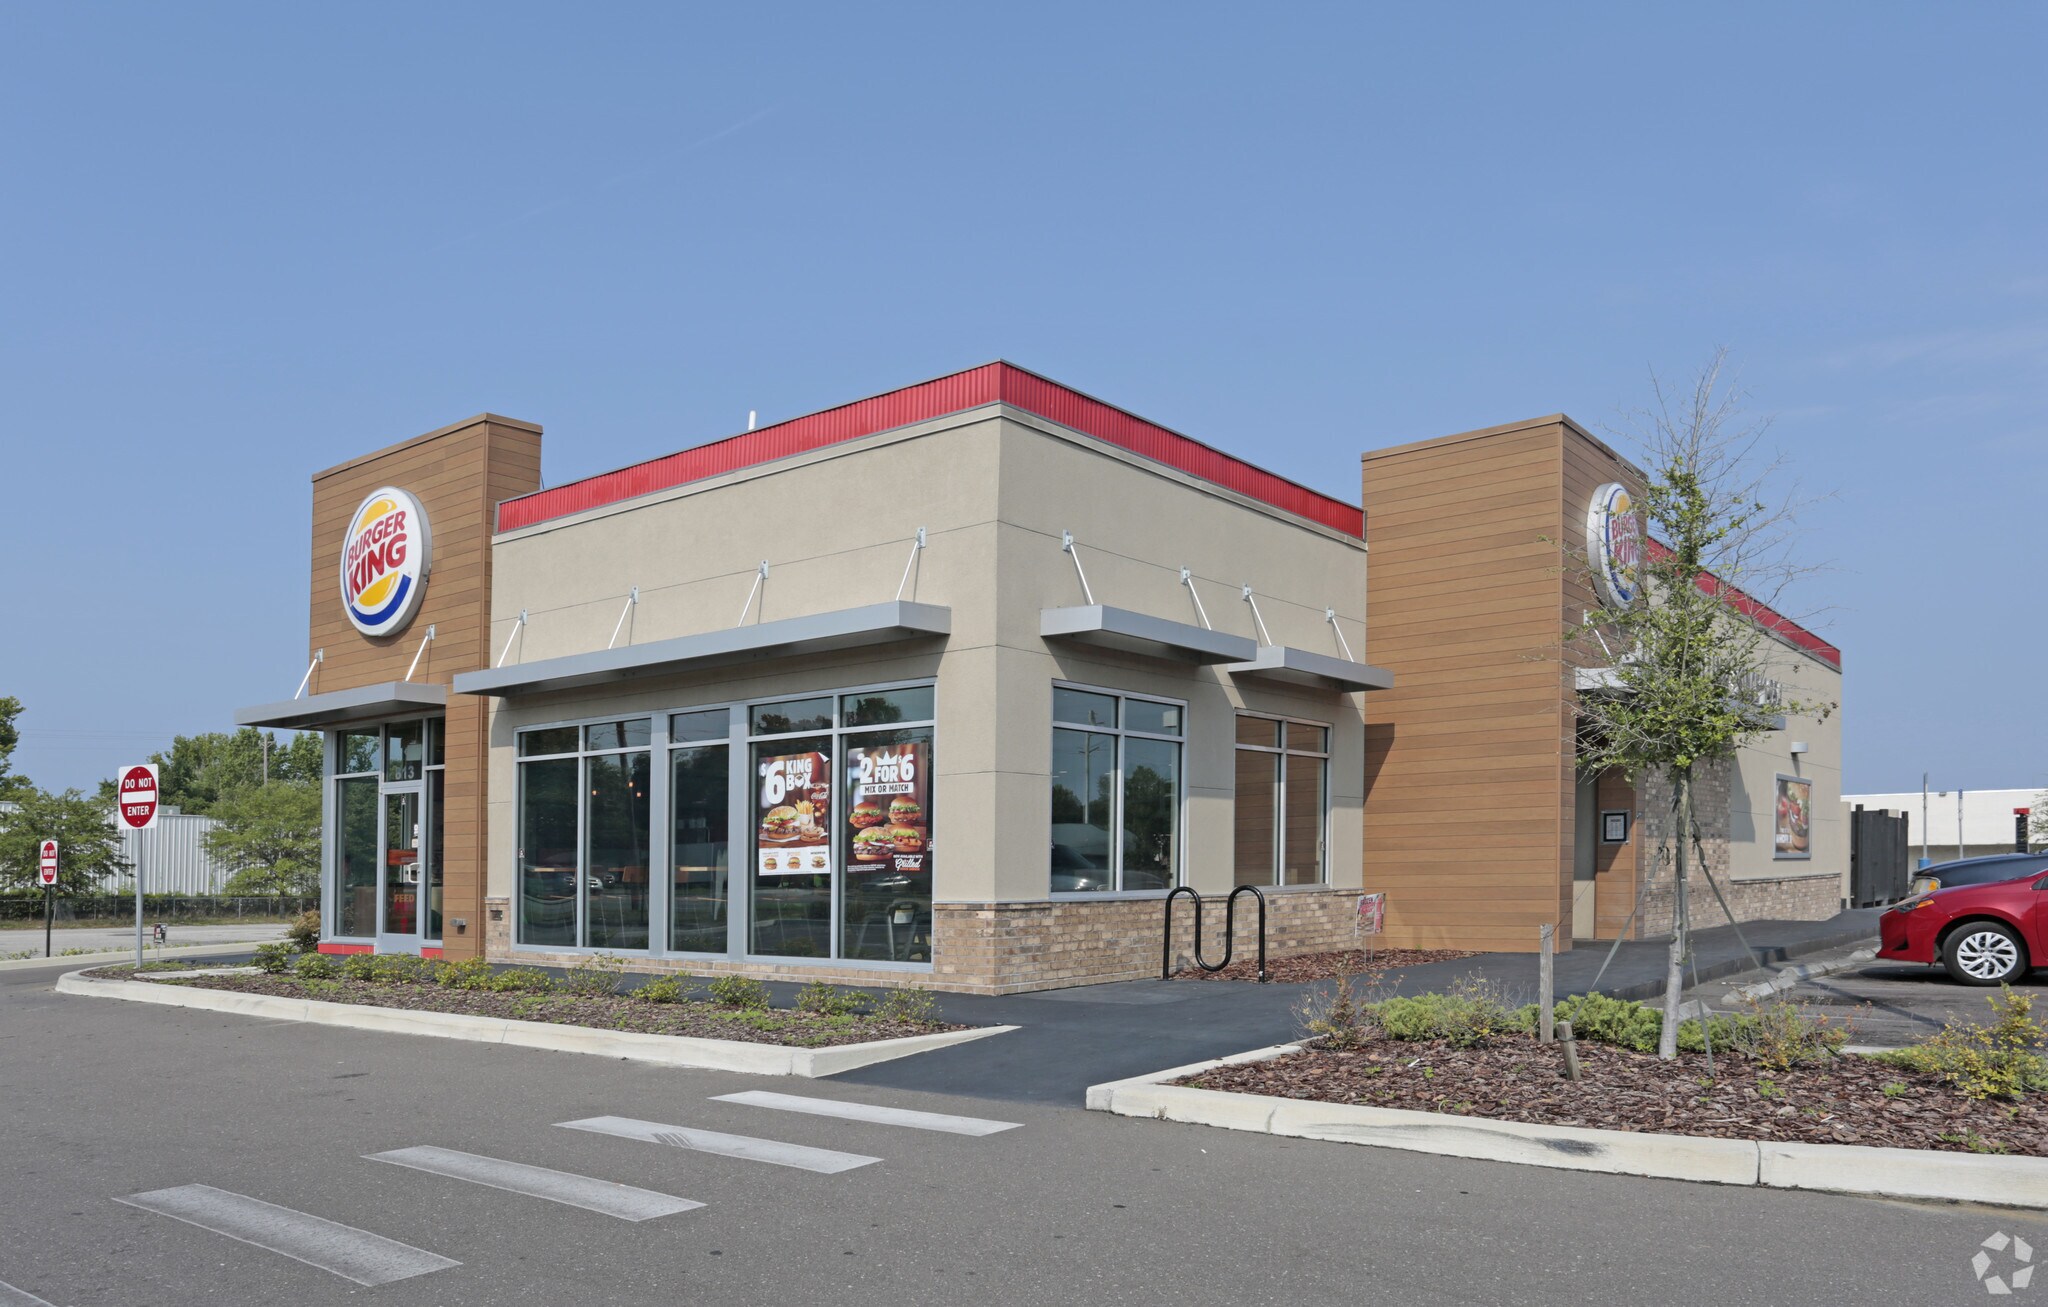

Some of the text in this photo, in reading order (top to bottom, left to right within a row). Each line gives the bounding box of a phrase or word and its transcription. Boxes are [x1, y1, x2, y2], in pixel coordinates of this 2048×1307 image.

[347, 510, 406, 571] BURGER
[349, 533, 407, 606] KING
[786, 758, 812, 774] KING
[874, 765, 899, 783] FOR
[125, 777, 152, 789] DO NOT
[864, 784, 909, 794] MIX OR MATCH
[127, 805, 150, 817] ENTER
[394, 894, 415, 902] FEED
